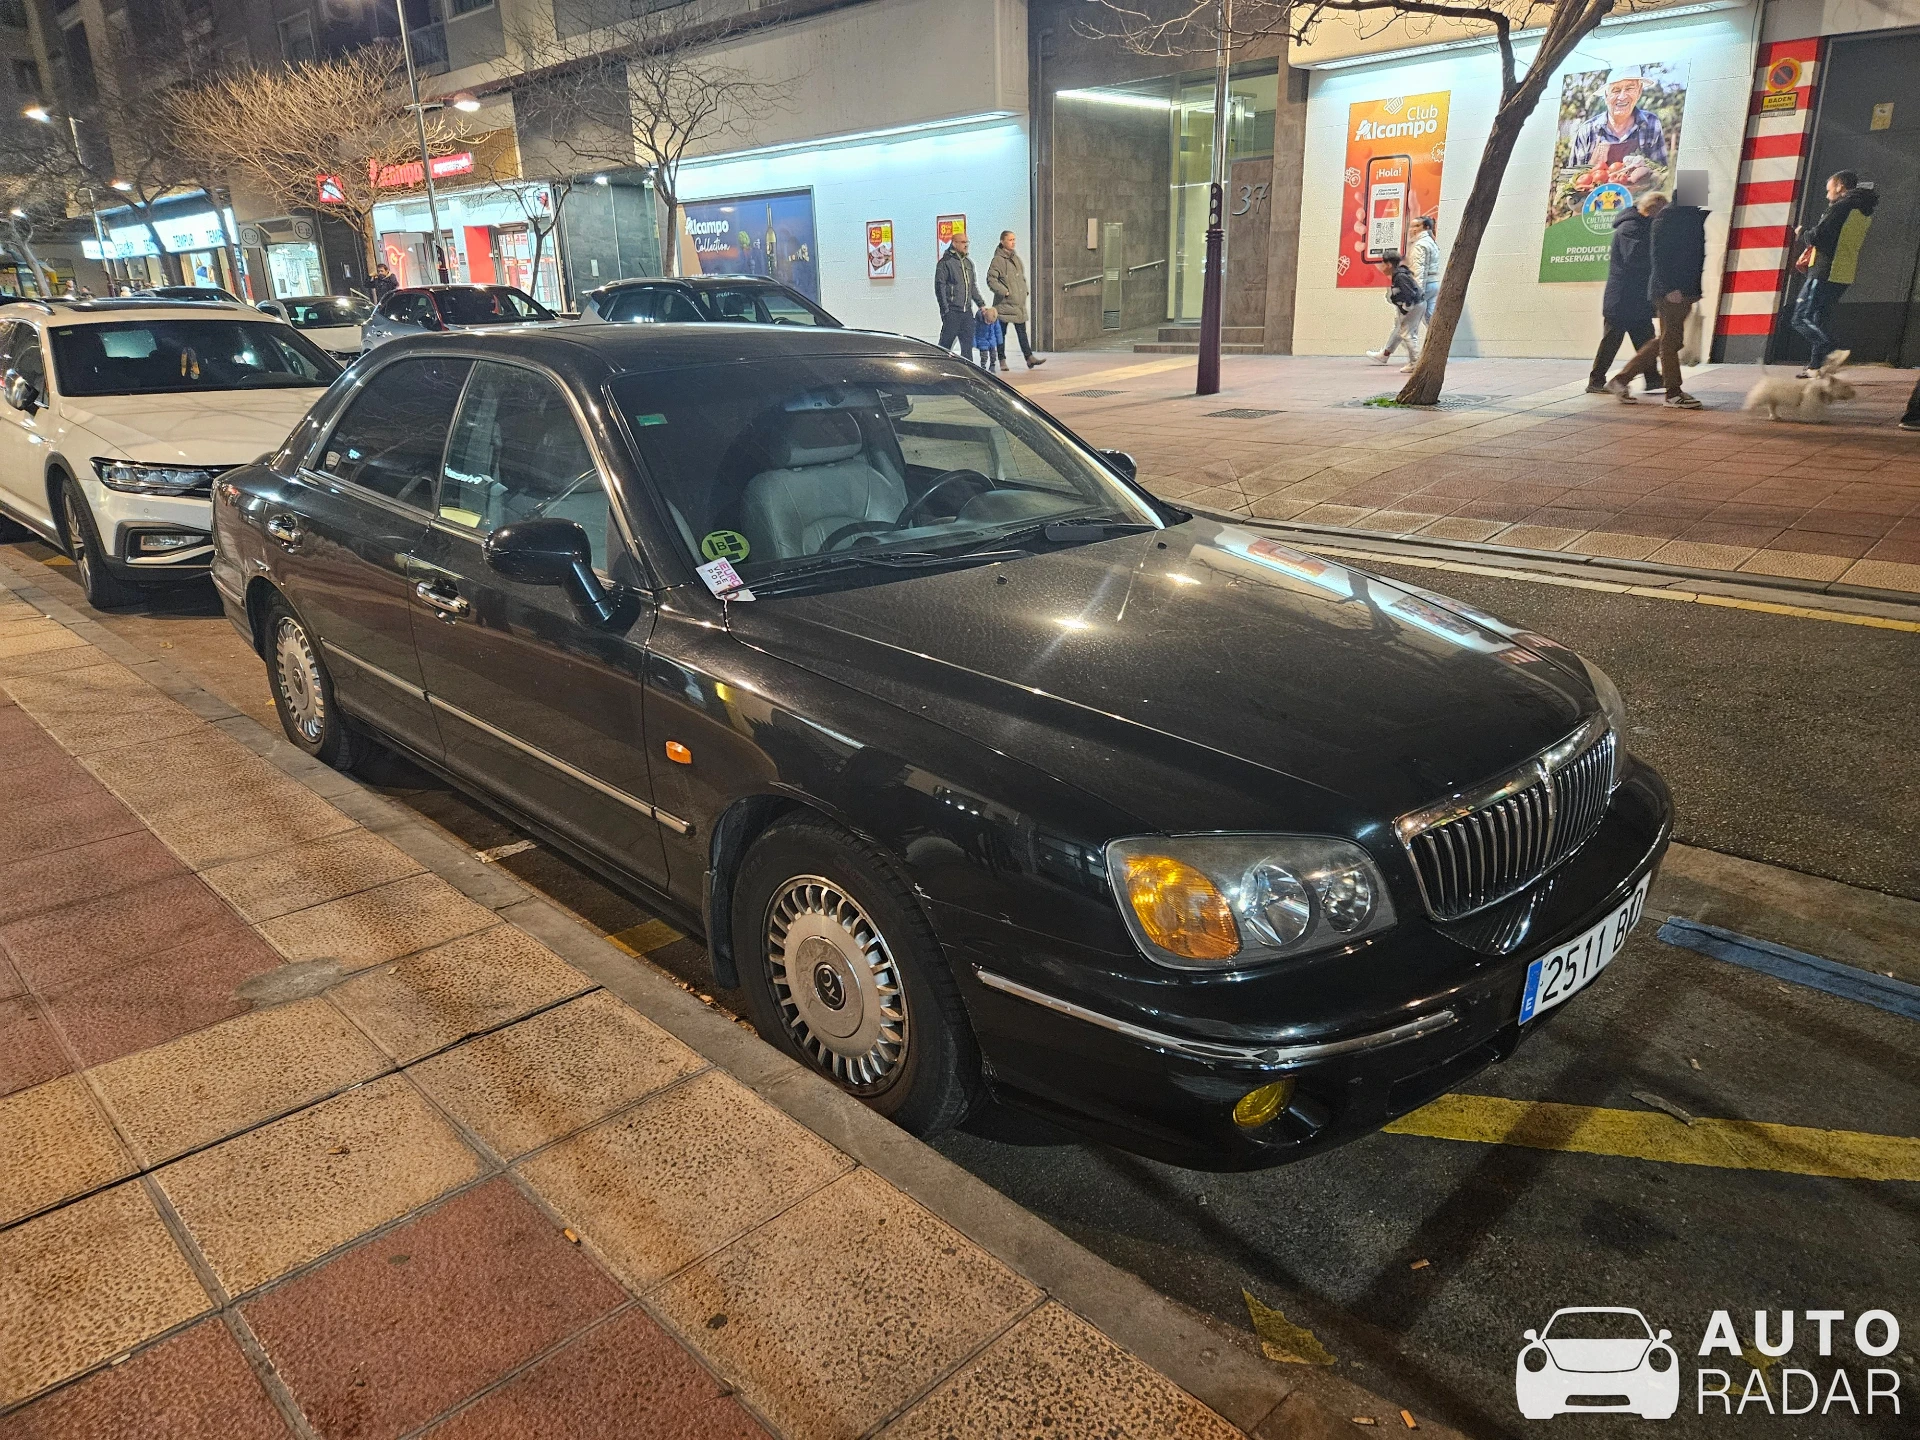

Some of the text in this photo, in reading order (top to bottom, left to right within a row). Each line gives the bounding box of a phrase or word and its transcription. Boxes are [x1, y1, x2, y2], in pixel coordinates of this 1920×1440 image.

[1407, 104, 1439, 120] Club
[1354, 119, 1438, 142] Alcampo
[1375, 167, 1402, 181] ¡Hola!
[1232, 182, 1271, 217] 37
[684, 216, 730, 237] Alcampo
[1594, 222, 1612, 230] BUEN
[694, 237, 731, 254] Collection
[1566, 246, 1606, 255] PRODUCIR
[1550, 255, 1595, 263] PRESERVAR
[1542, 925, 1607, 1004] 2511
[1525, 996, 1534, 1011] E
